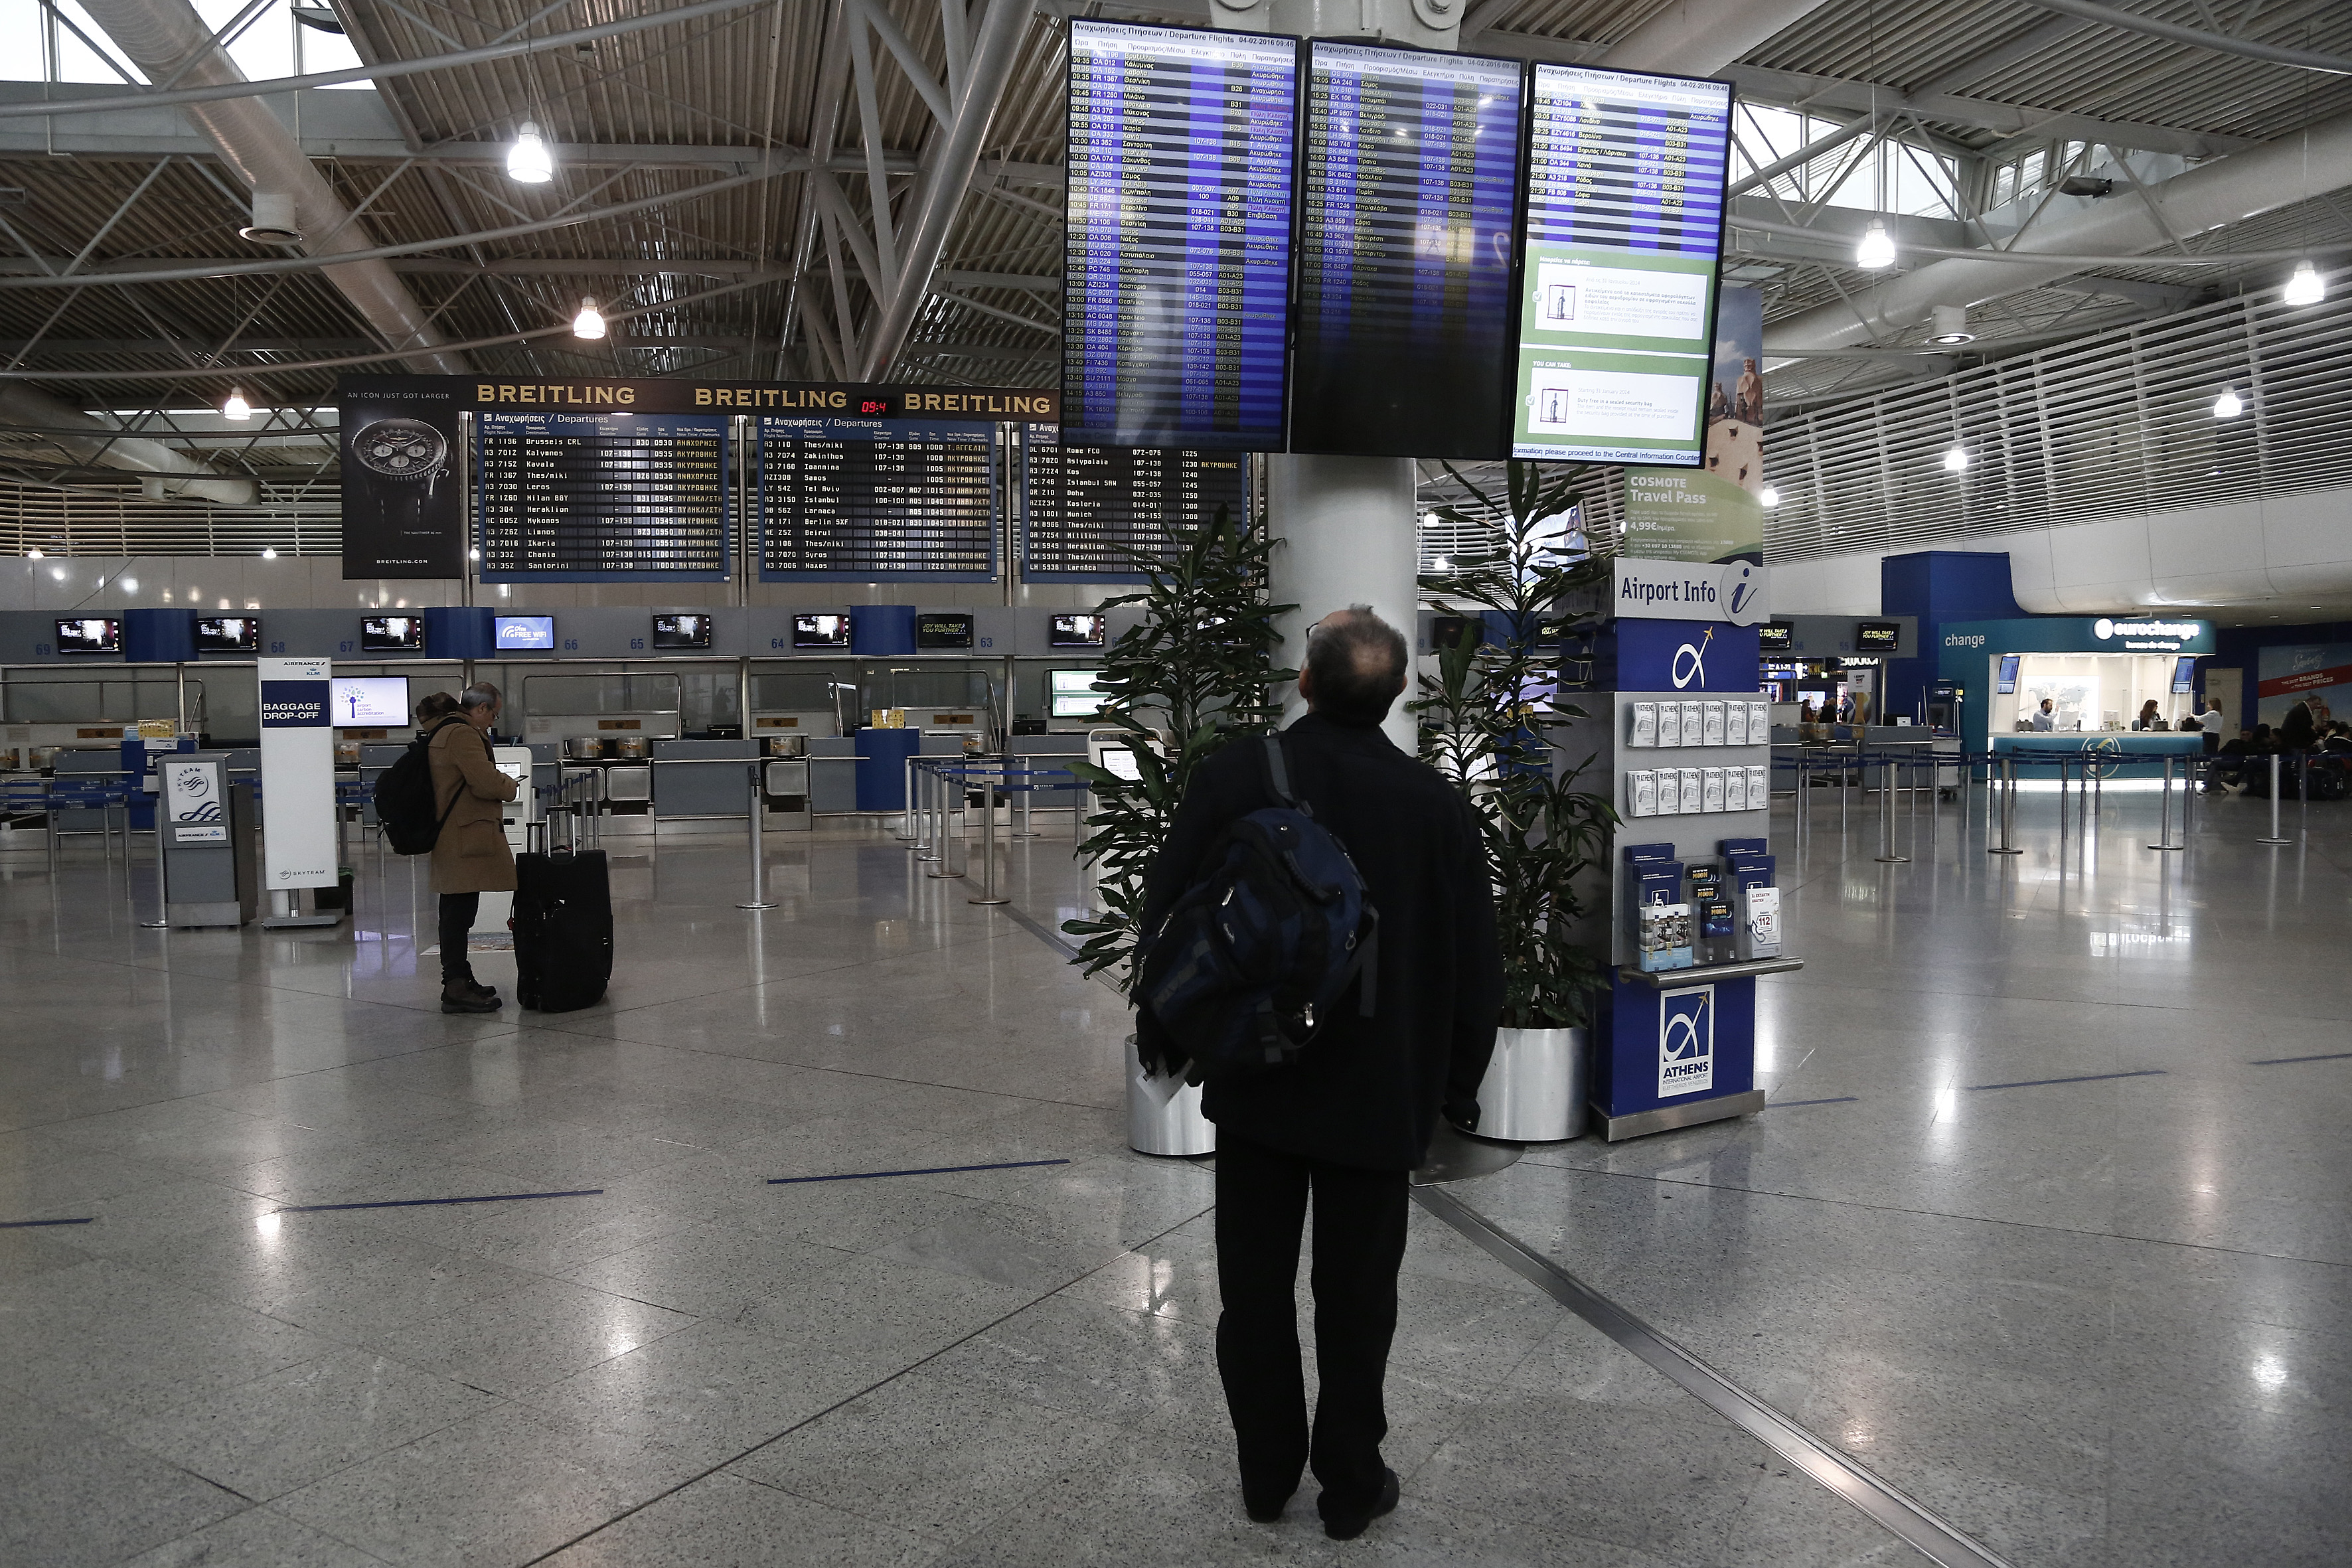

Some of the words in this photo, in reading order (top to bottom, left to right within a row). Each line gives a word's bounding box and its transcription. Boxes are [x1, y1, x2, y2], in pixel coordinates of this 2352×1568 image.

[1074, 23, 1126, 35] Αναχωρήσεις
[1129, 27, 1162, 37] Πτήσεων
[1170, 31, 1206, 40] Departure
[1209, 35, 1234, 44] Flights
[1239, 37, 1274, 45] 04-02-2016
[1125, 60, 1154, 70] Κάλυμνος
[1252, 71, 1285, 80] Ακυρώθηκε
[477, 384, 635, 404] BREITLING
[695, 388, 847, 408] BREITLING
[904, 393, 1050, 414] BREITLING
[495, 414, 545, 424] Αναχωρήσεις
[558, 414, 608, 424] Departures
[775, 418, 823, 428] Αναχωρήσεις
[834, 419, 882, 428] Departures
[1630, 477, 1686, 489] COSMOTE
[1630, 489, 1672, 503] Travel
[1676, 492, 1706, 504] Pass
[1621, 577, 1678, 605] Airport
[1684, 580, 1716, 603] Info
[2114, 620, 2199, 640] eurochange
[340, 641, 354, 652] 67
[565, 639, 578, 650] 66
[631, 639, 644, 649] 65
[771, 637, 784, 649] 64
[980, 637, 993, 648] 63
[1794, 641, 1804, 650] 56
[1840, 642, 1849, 651] 55
[1945, 634, 1985, 648] change
[35, 644, 51, 656] 69
[271, 642, 285, 653] 68
[178, 767, 200, 791] SKYTEAM
[1759, 917, 1770, 925] 112
[1663, 1061, 1708, 1079] ATHENS
